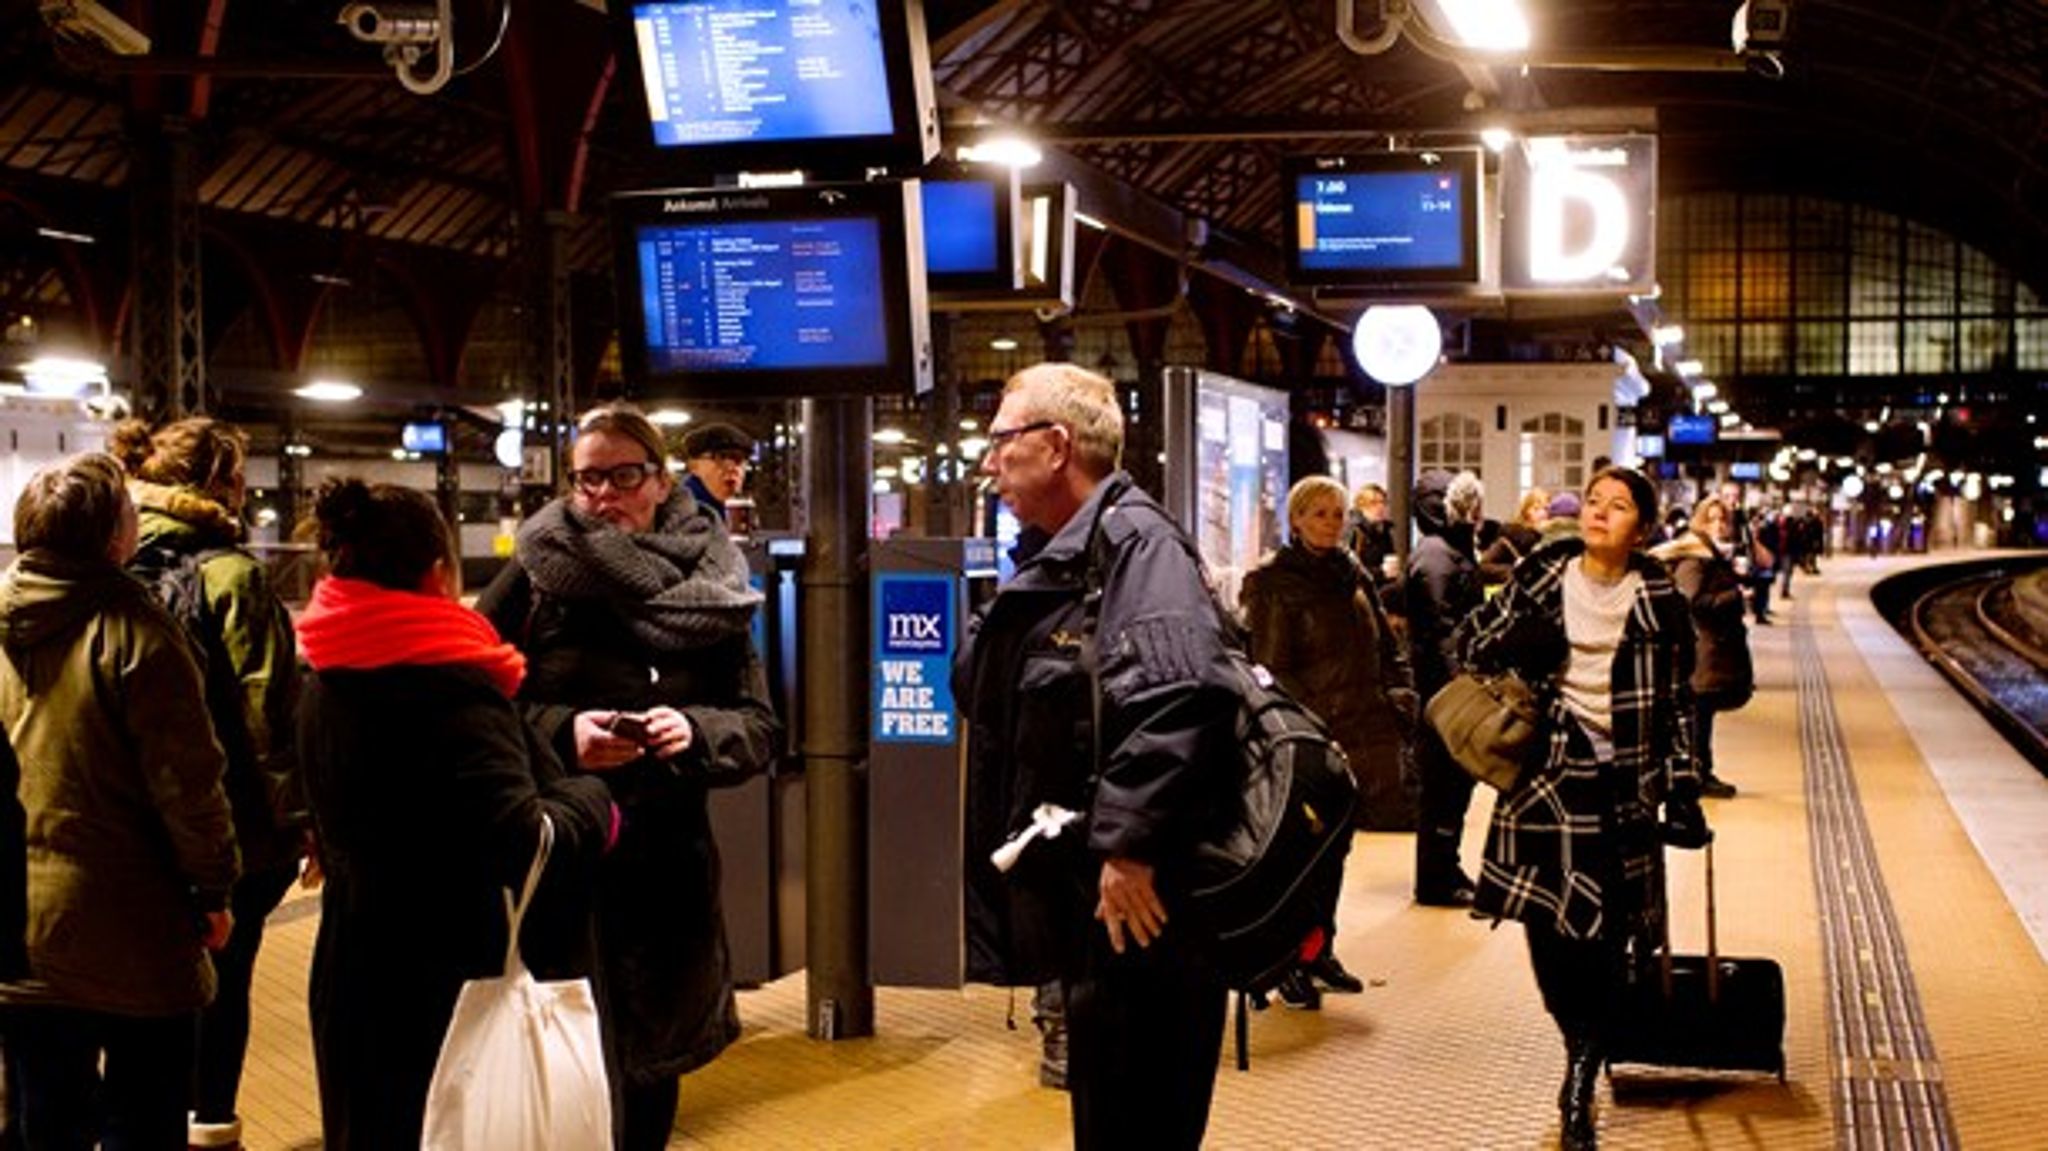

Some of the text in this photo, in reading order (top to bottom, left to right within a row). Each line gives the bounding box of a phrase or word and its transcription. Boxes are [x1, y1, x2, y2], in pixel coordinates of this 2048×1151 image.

[1531, 166, 1628, 281] D
[889, 613, 941, 639] mx
[881, 660, 923, 684] WE
[881, 687, 934, 708] ARE
[882, 711, 948, 736] FREE
